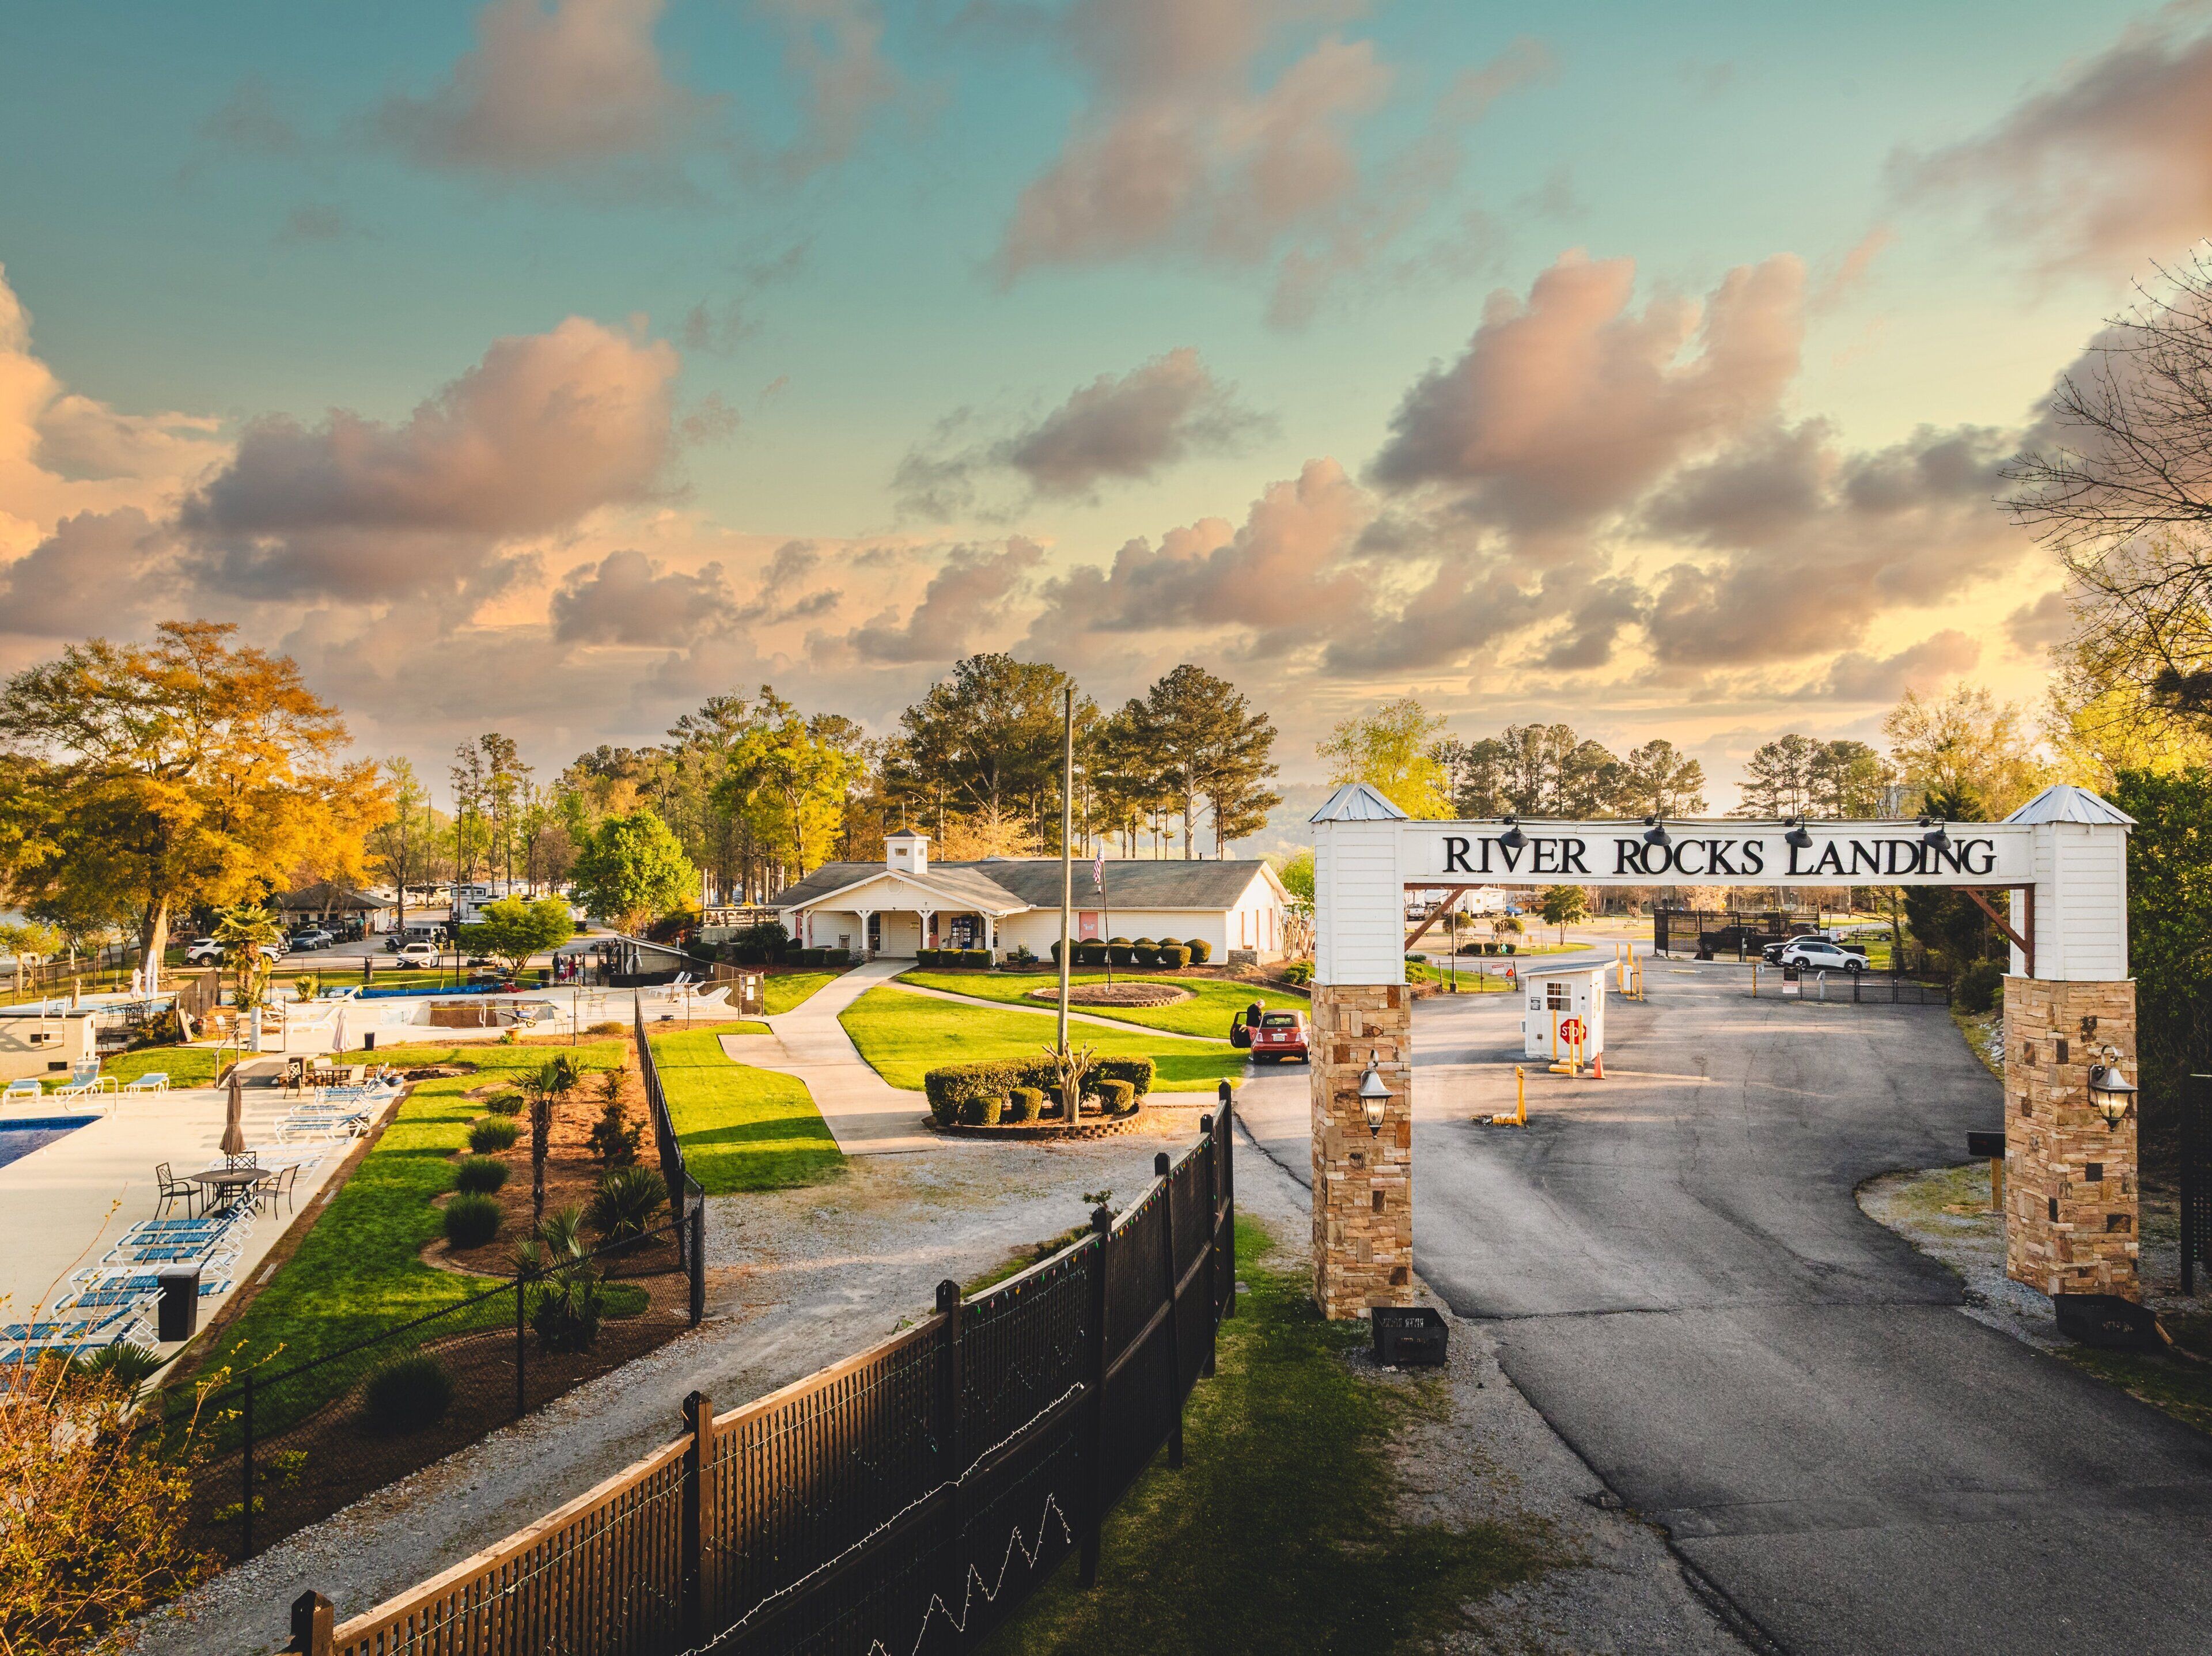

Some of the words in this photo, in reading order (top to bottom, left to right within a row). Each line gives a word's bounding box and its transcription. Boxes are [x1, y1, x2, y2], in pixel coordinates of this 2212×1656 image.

[1442, 837, 1592, 873] RIVER
[1612, 839, 1764, 875] ROCKS
[1785, 839, 1997, 875] LANDING
